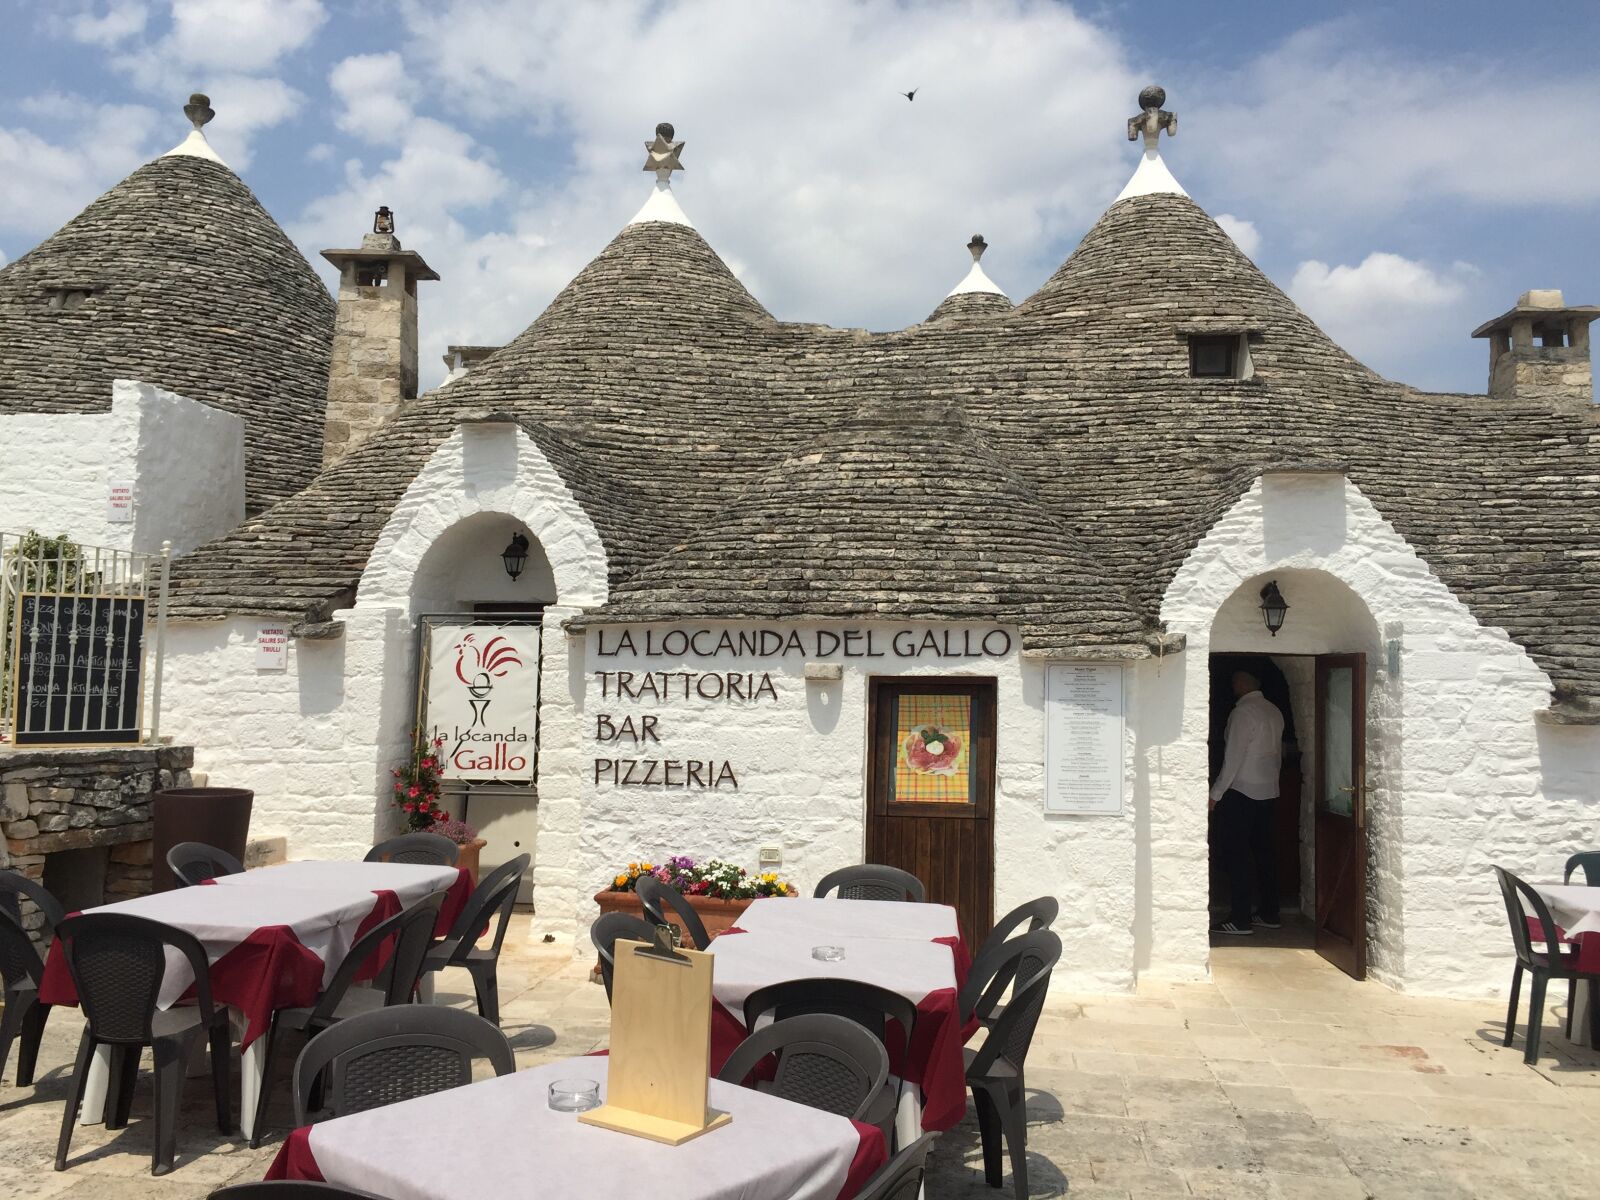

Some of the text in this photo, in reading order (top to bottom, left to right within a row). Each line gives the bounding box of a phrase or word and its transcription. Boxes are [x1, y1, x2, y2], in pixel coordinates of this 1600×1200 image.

[598, 629, 1012, 657] LA LOCANDA DEL GALLO
[595, 671, 779, 702] TRATTORIA
[433, 724, 527, 743] la locanda
[595, 713, 661, 743] BAR
[454, 742, 526, 771] Gallo
[594, 758, 739, 788] PIZZERIA
